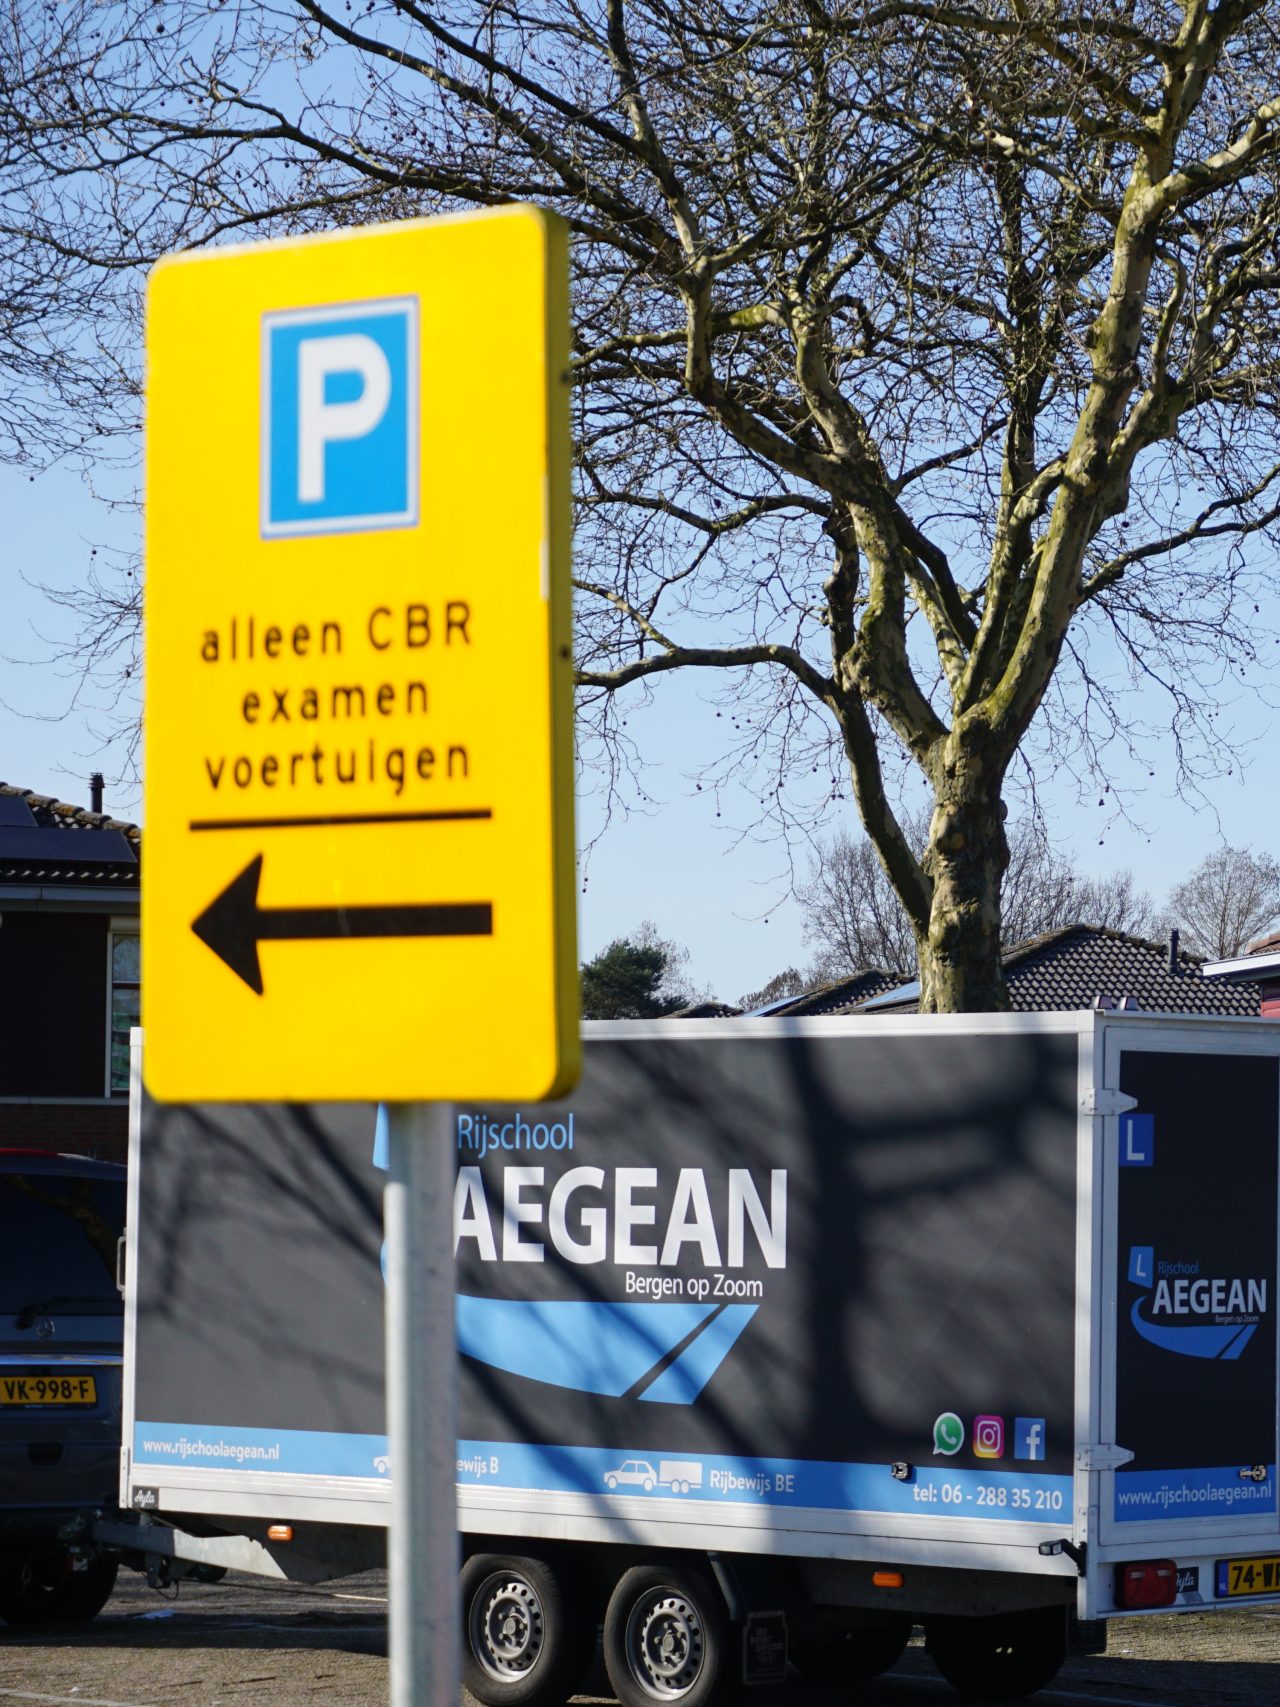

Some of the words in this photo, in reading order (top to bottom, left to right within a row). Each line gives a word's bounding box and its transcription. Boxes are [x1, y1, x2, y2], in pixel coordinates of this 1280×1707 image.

[298, 333, 393, 503] P
[200, 615, 342, 663] alleen
[367, 600, 471, 652] CBR
[241, 681, 428, 725] examen
[204, 737, 469, 797] voertuigen
[457, 1112, 575, 1158] Rijschool
[1127, 1119, 1145, 1161] L
[453, 1166, 788, 1269] AEGEAN
[1136, 1253, 1147, 1278] L
[1158, 1260, 1200, 1277] Rijschool
[625, 1271, 683, 1300] Bergen
[686, 1280, 710, 1301] op
[713, 1274, 763, 1297] Zoom
[1152, 1279, 1267, 1315] AEGEAN
[1215, 1314, 1234, 1325] Bergen
[1235, 1316, 1243, 1324] op
[1244, 1314, 1260, 1322] Zoom
[4, 1380, 89, 1400] VK-998-F
[142, 1438, 280, 1462] www.rijschoolaegean.nl
[456, 1456, 488, 1478] ewijs
[490, 1456, 499, 1475] B
[134, 1489, 155, 1506] Ayla
[710, 1469, 771, 1497] Rijbewijs
[775, 1474, 795, 1493] BE
[913, 1483, 937, 1503] tel:
[941, 1484, 962, 1504] 06
[976, 1486, 1007, 1507] 288
[1011, 1488, 1031, 1508] 35
[1035, 1490, 1063, 1511] 210
[1118, 1480, 1272, 1509] www.rijschoolaegean.nl
